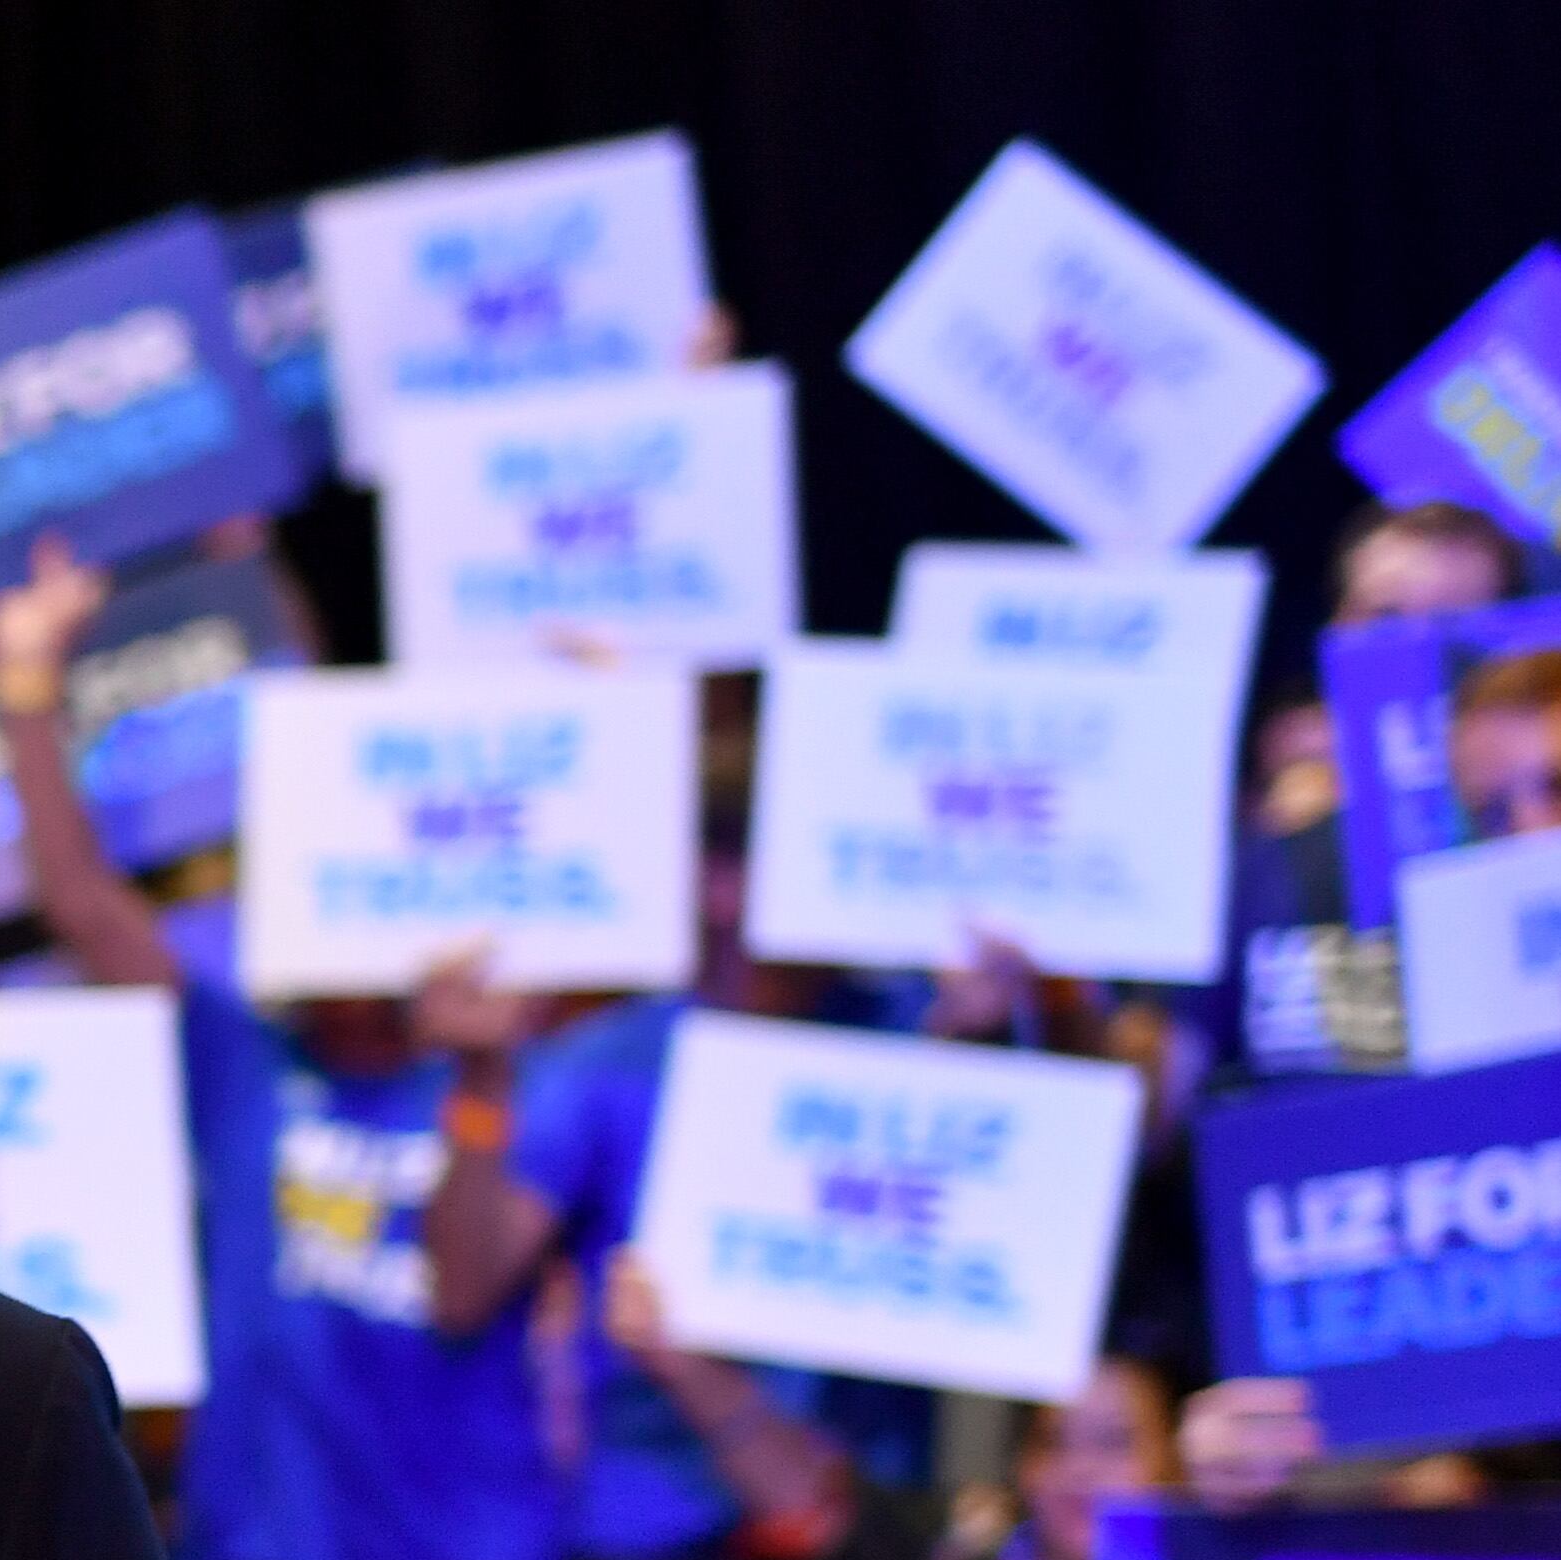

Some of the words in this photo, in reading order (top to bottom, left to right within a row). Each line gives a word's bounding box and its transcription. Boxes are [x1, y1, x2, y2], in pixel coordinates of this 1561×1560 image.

[1, 303, 201, 424] FOR
[819, 1168, 945, 1226] WE
[1245, 1165, 1391, 1285] LIZ
[1257, 1245, 1561, 1374] LEADE
